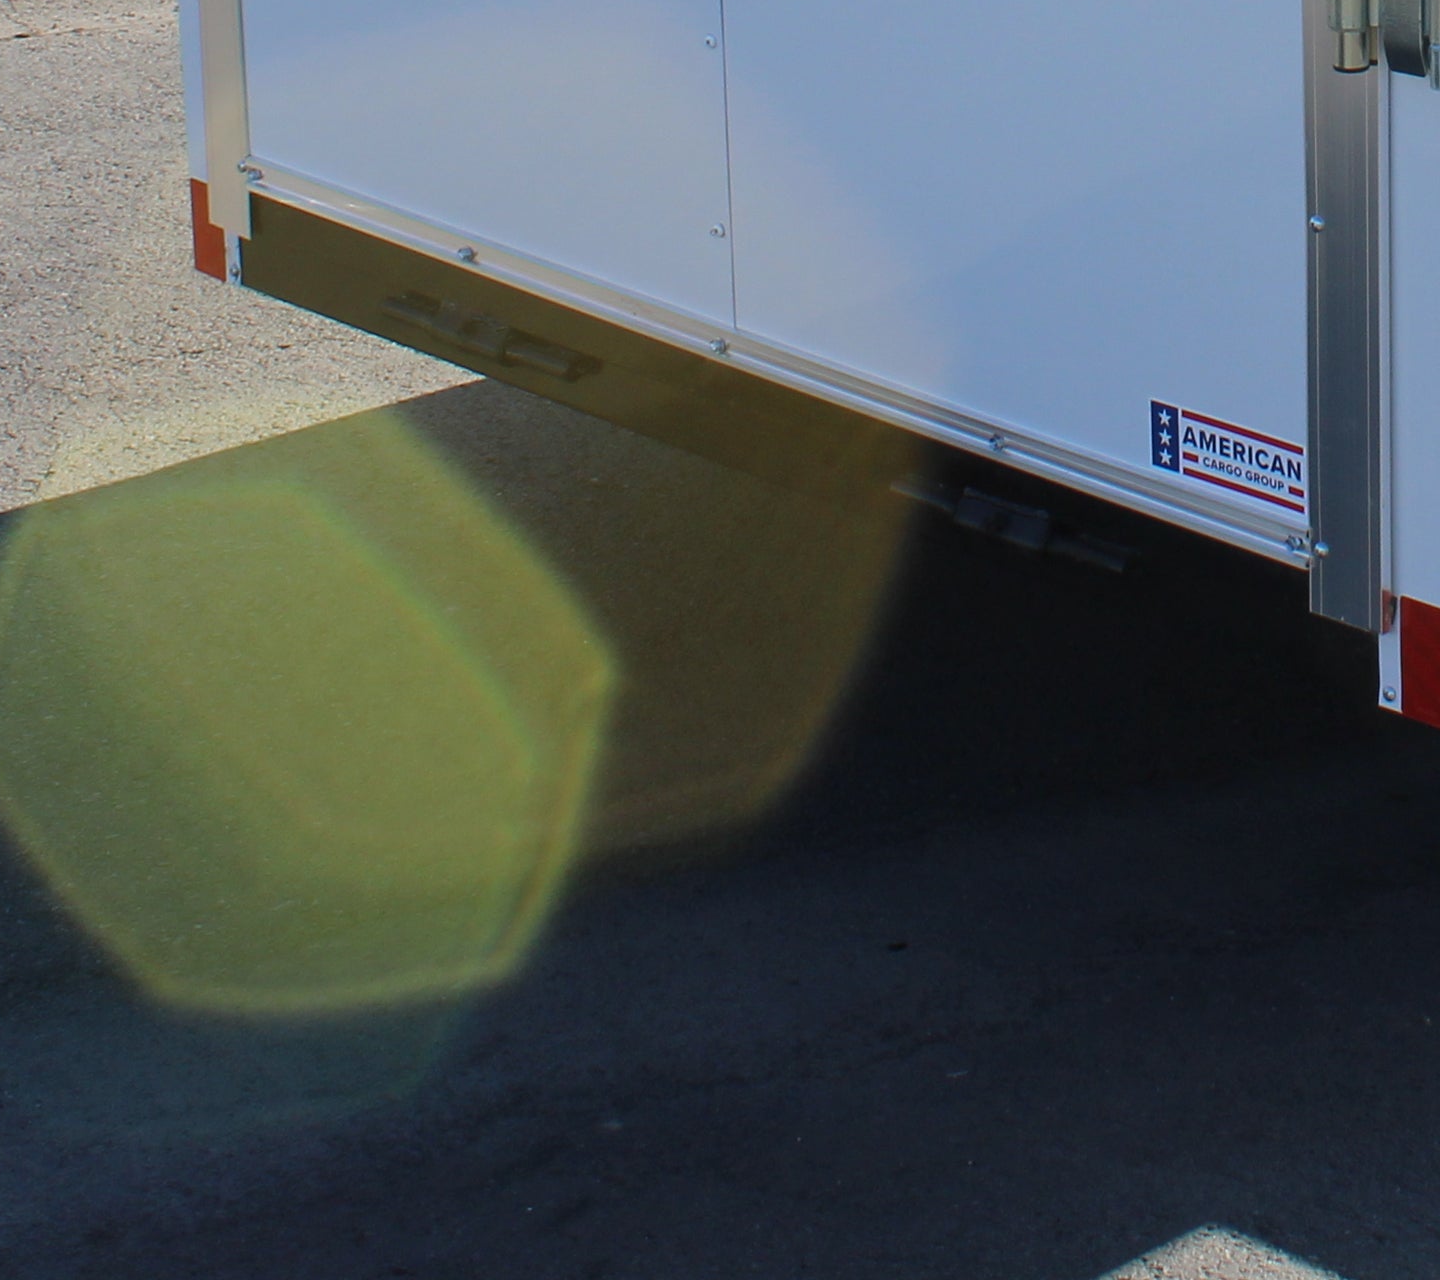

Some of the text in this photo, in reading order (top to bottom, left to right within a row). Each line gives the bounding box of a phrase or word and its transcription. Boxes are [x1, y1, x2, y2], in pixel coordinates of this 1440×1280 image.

[1182, 426, 1302, 482] AMERICAN
[1202, 456, 1285, 491] CARGO GROUP
